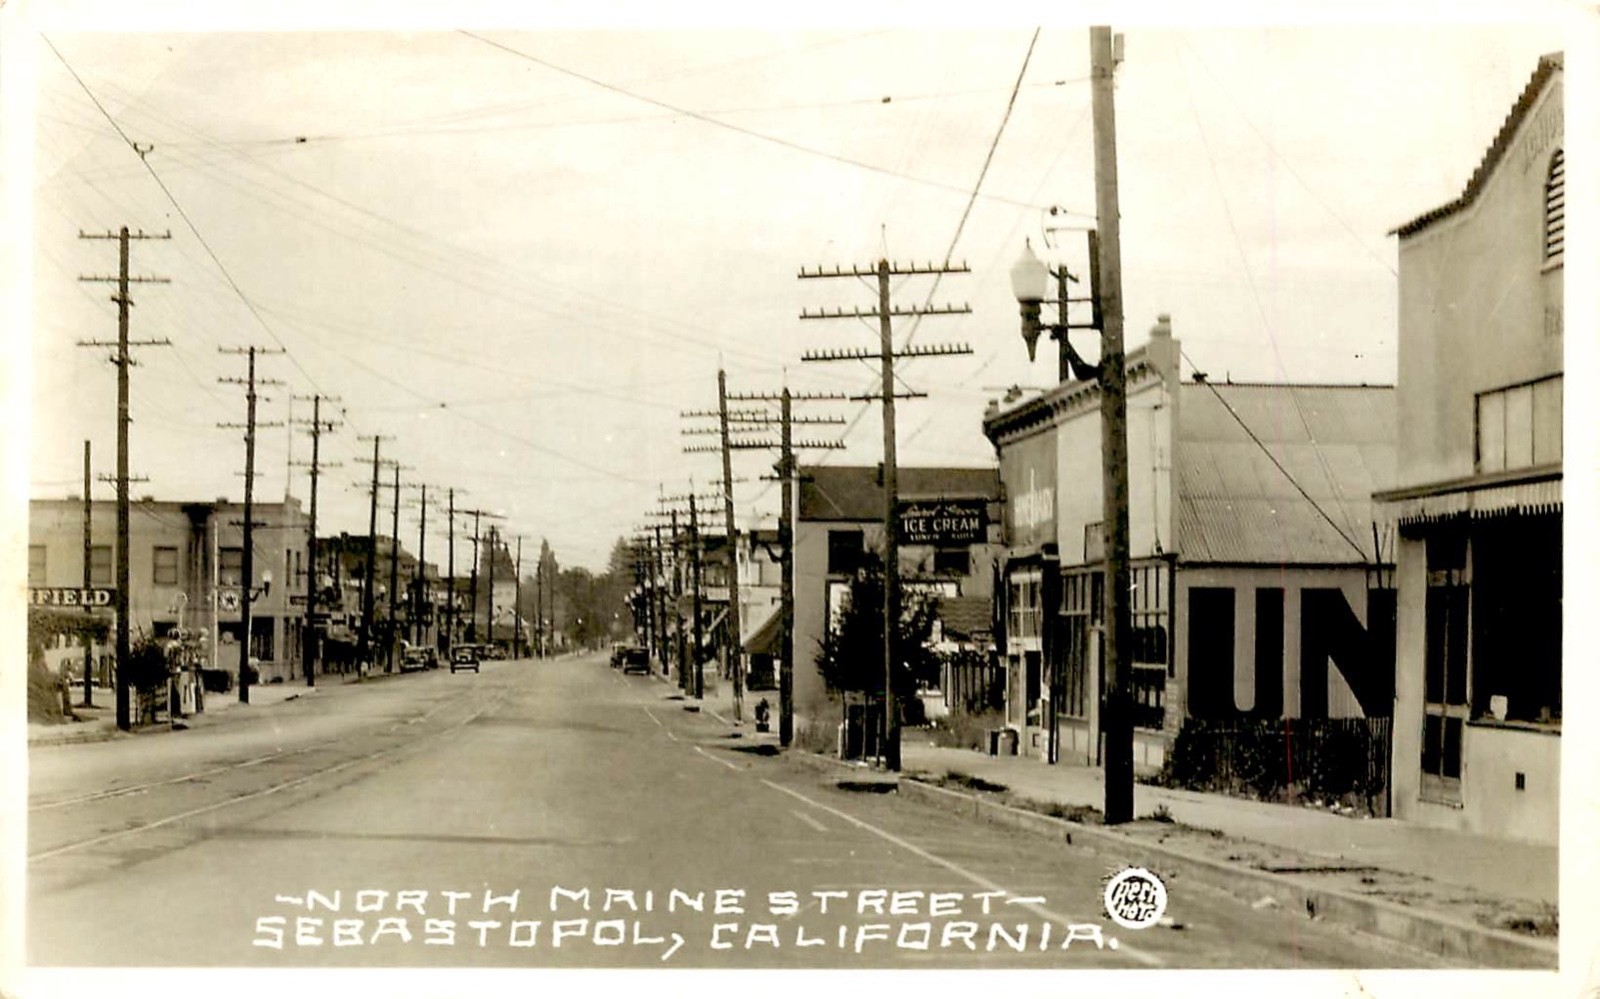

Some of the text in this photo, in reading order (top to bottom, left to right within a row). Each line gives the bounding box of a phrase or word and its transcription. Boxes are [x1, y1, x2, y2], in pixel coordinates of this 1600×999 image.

[904, 517, 979, 533] ICE CREAM
[1187, 586, 1397, 720] UN
